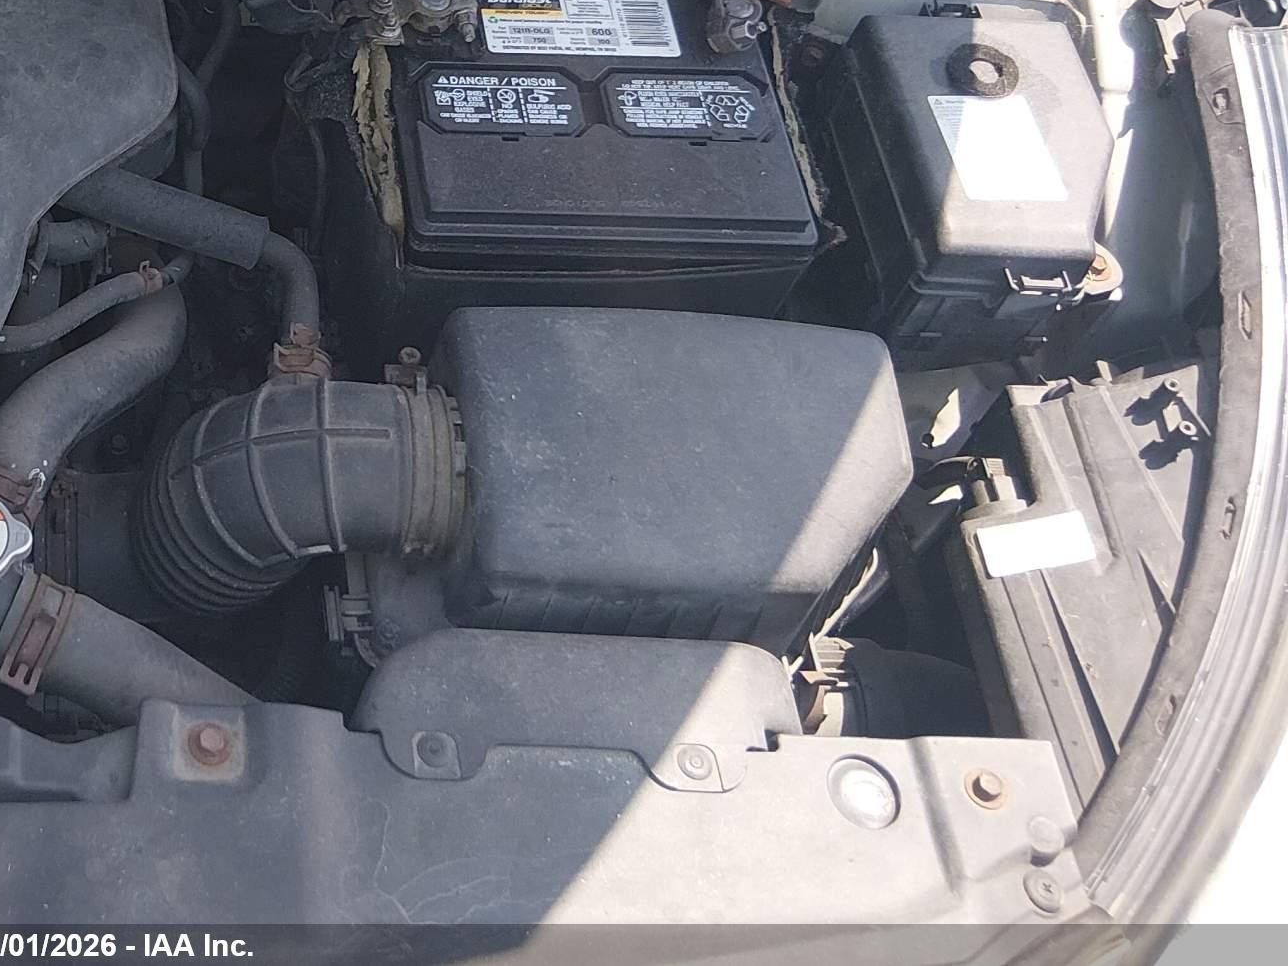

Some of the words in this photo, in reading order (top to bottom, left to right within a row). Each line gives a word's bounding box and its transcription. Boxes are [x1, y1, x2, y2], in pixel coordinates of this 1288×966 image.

[591, 28, 612, 36] 600
[449, 76, 499, 85] DANGER
[501, 77, 509, 86] /
[510, 78, 556, 86] POISON
